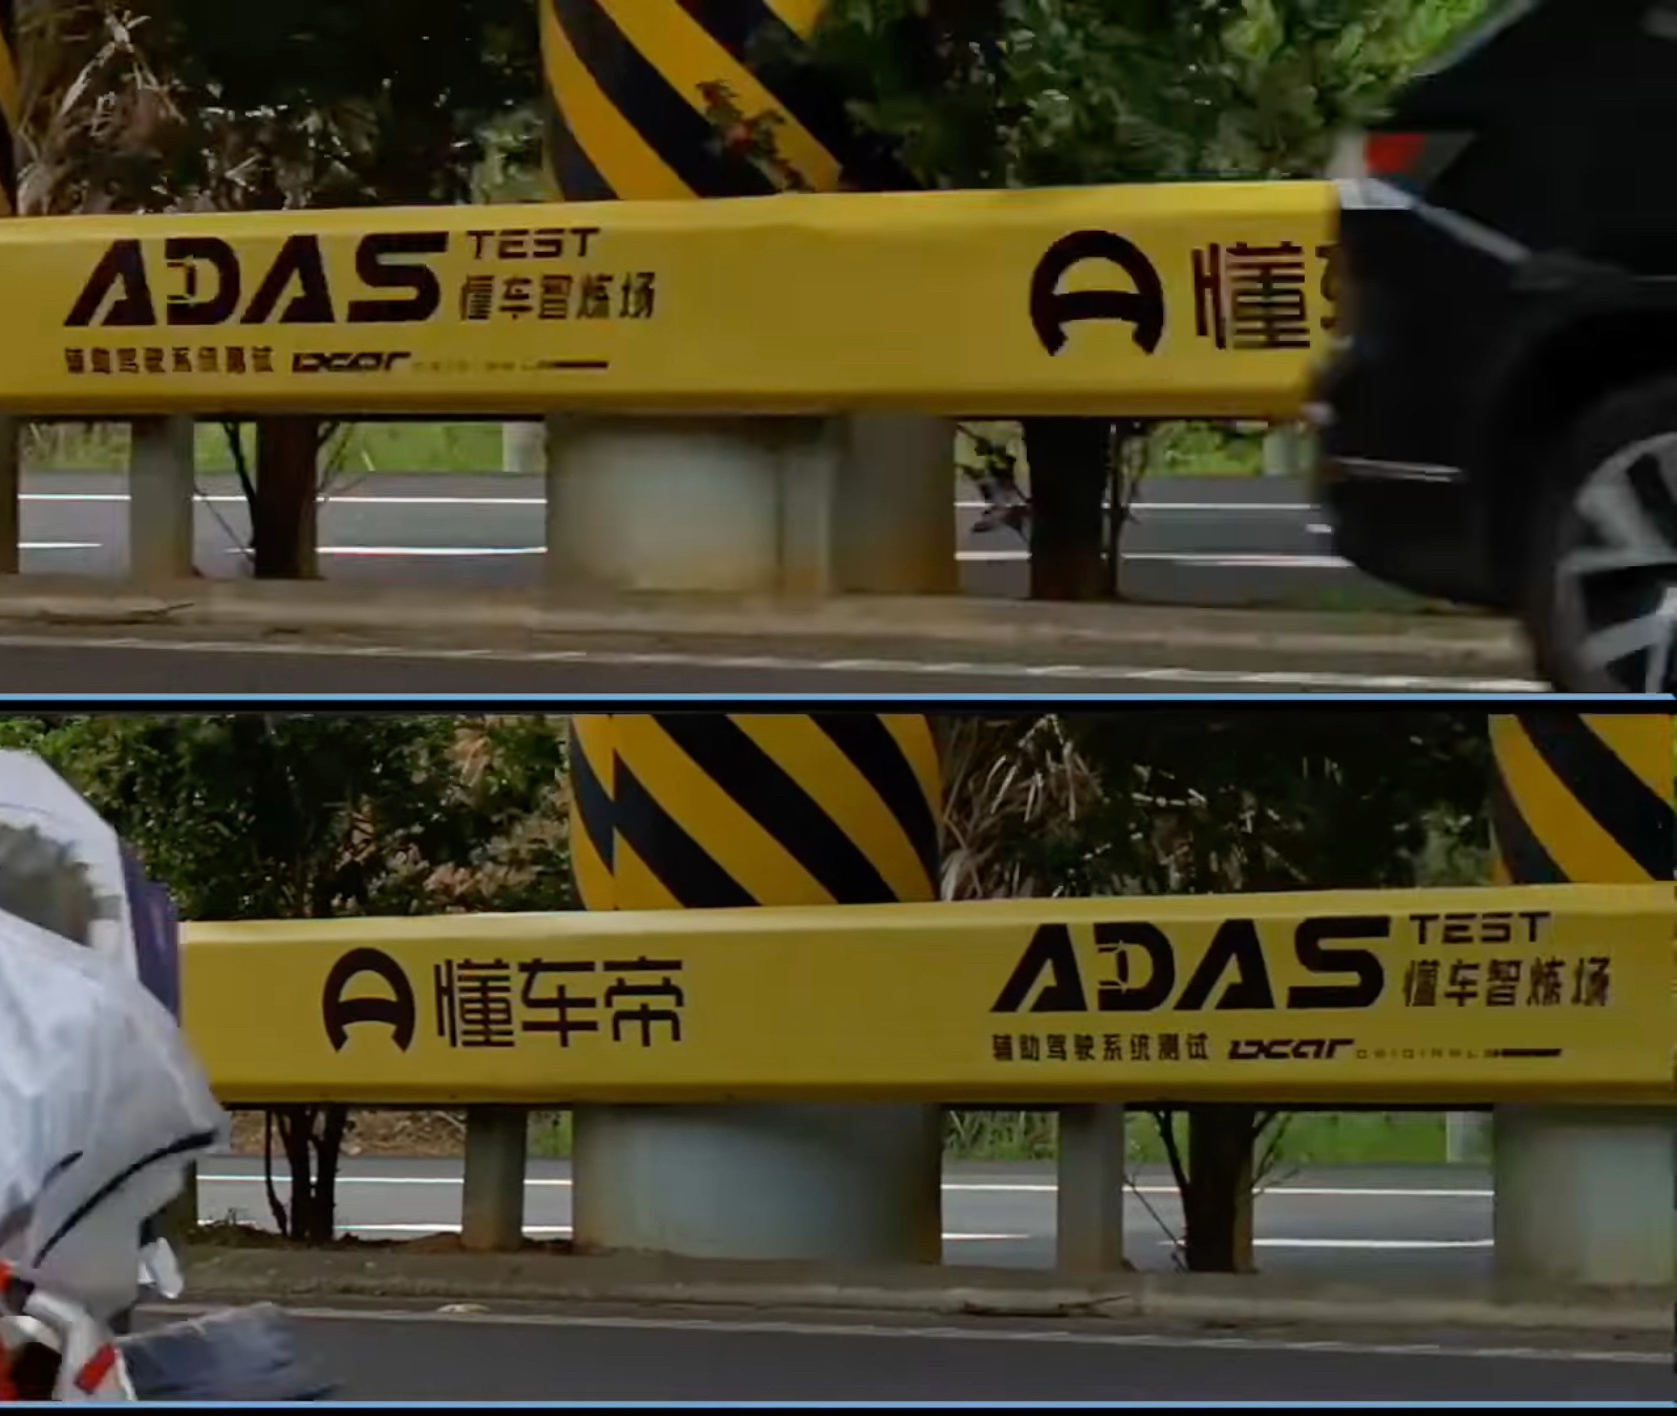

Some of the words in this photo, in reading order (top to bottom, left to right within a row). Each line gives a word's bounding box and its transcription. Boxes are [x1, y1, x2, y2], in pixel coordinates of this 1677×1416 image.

[63, 230, 449, 327] ADAS
[465, 227, 602, 260] TEST
[990, 914, 1391, 1013] ADAS
[1408, 911, 1552, 945] TEST
[434, 955, 686, 1049] 懂车帝
